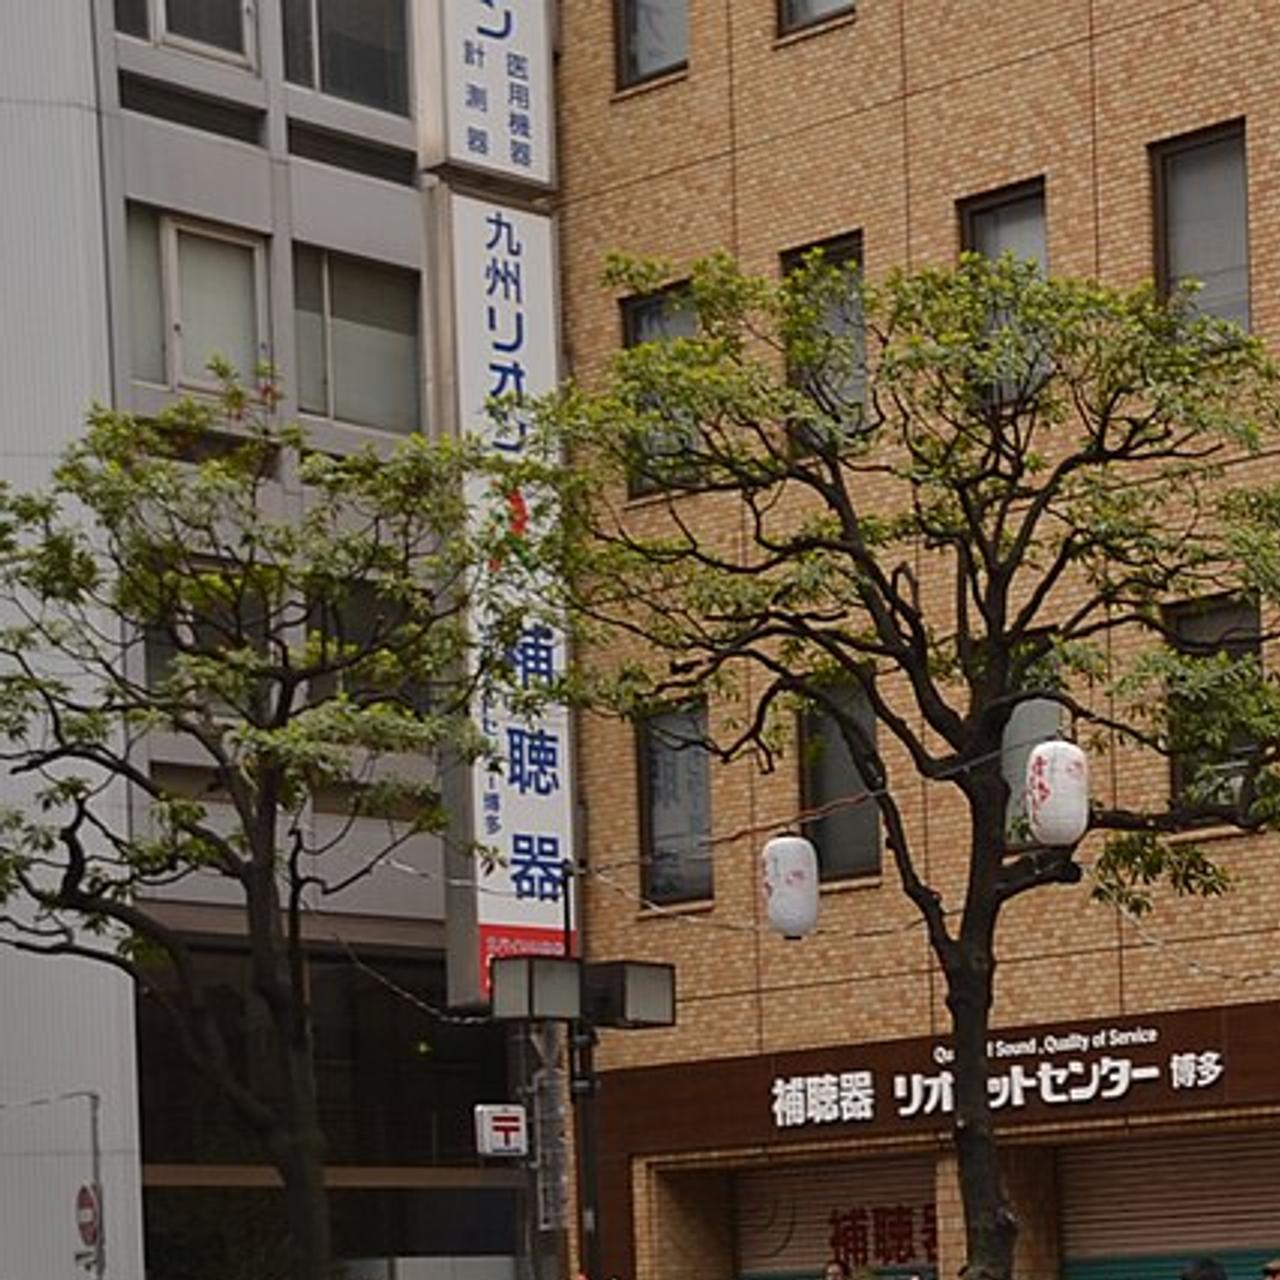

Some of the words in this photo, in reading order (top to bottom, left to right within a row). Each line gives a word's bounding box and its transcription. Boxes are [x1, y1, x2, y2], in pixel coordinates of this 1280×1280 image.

[1109, 1026, 1159, 1047] Service
[771, 1070, 875, 1127] 補聴器
[893, 1056, 1161, 1117] リオットセンター
[1170, 1051, 1224, 1089] 博多
